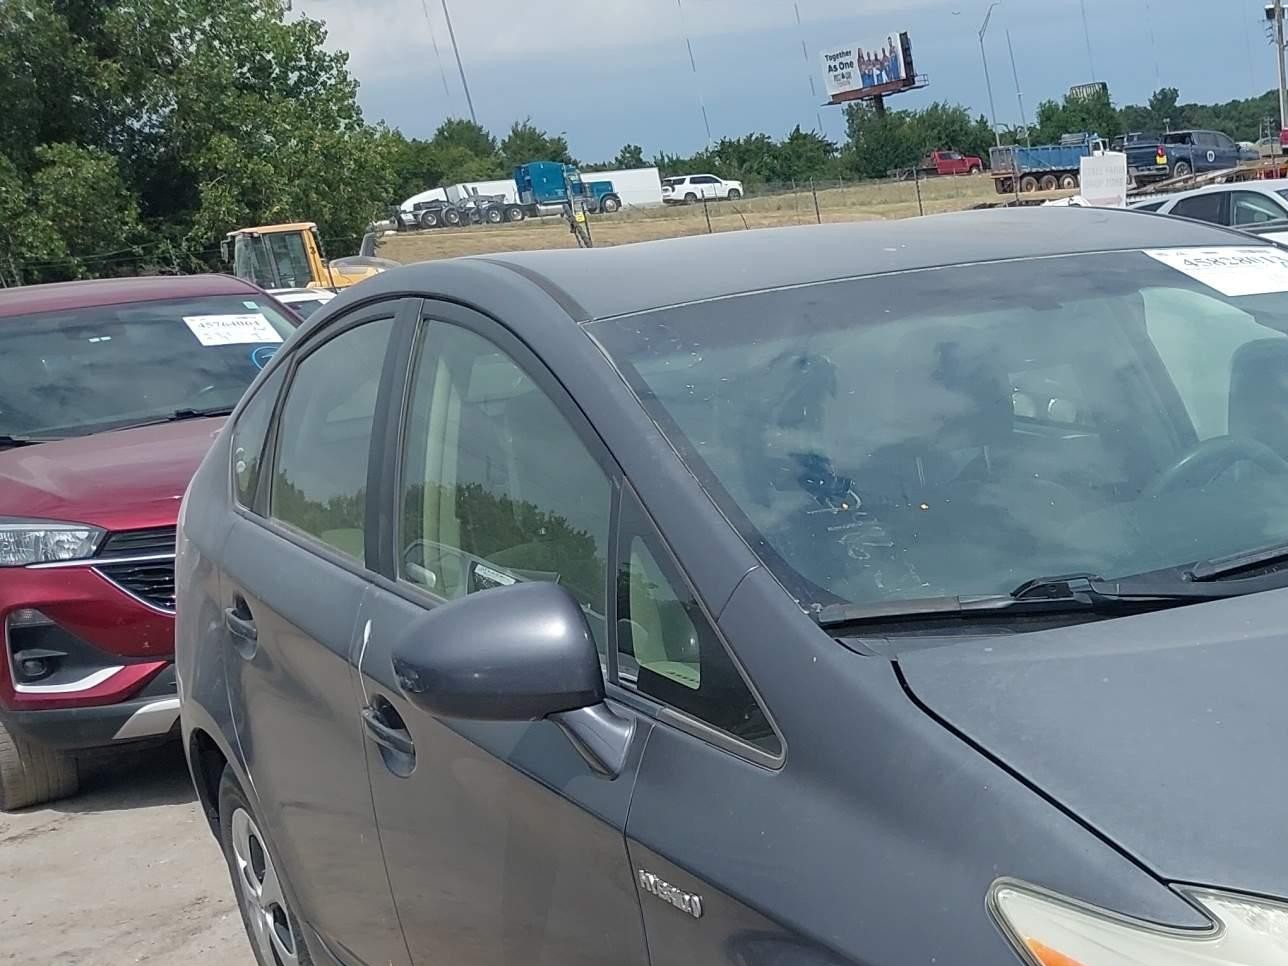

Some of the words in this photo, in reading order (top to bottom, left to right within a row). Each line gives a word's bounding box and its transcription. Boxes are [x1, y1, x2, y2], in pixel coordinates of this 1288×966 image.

[824, 49, 851, 61] Together
[828, 64, 838, 72] As
[838, 60, 853, 70] One
